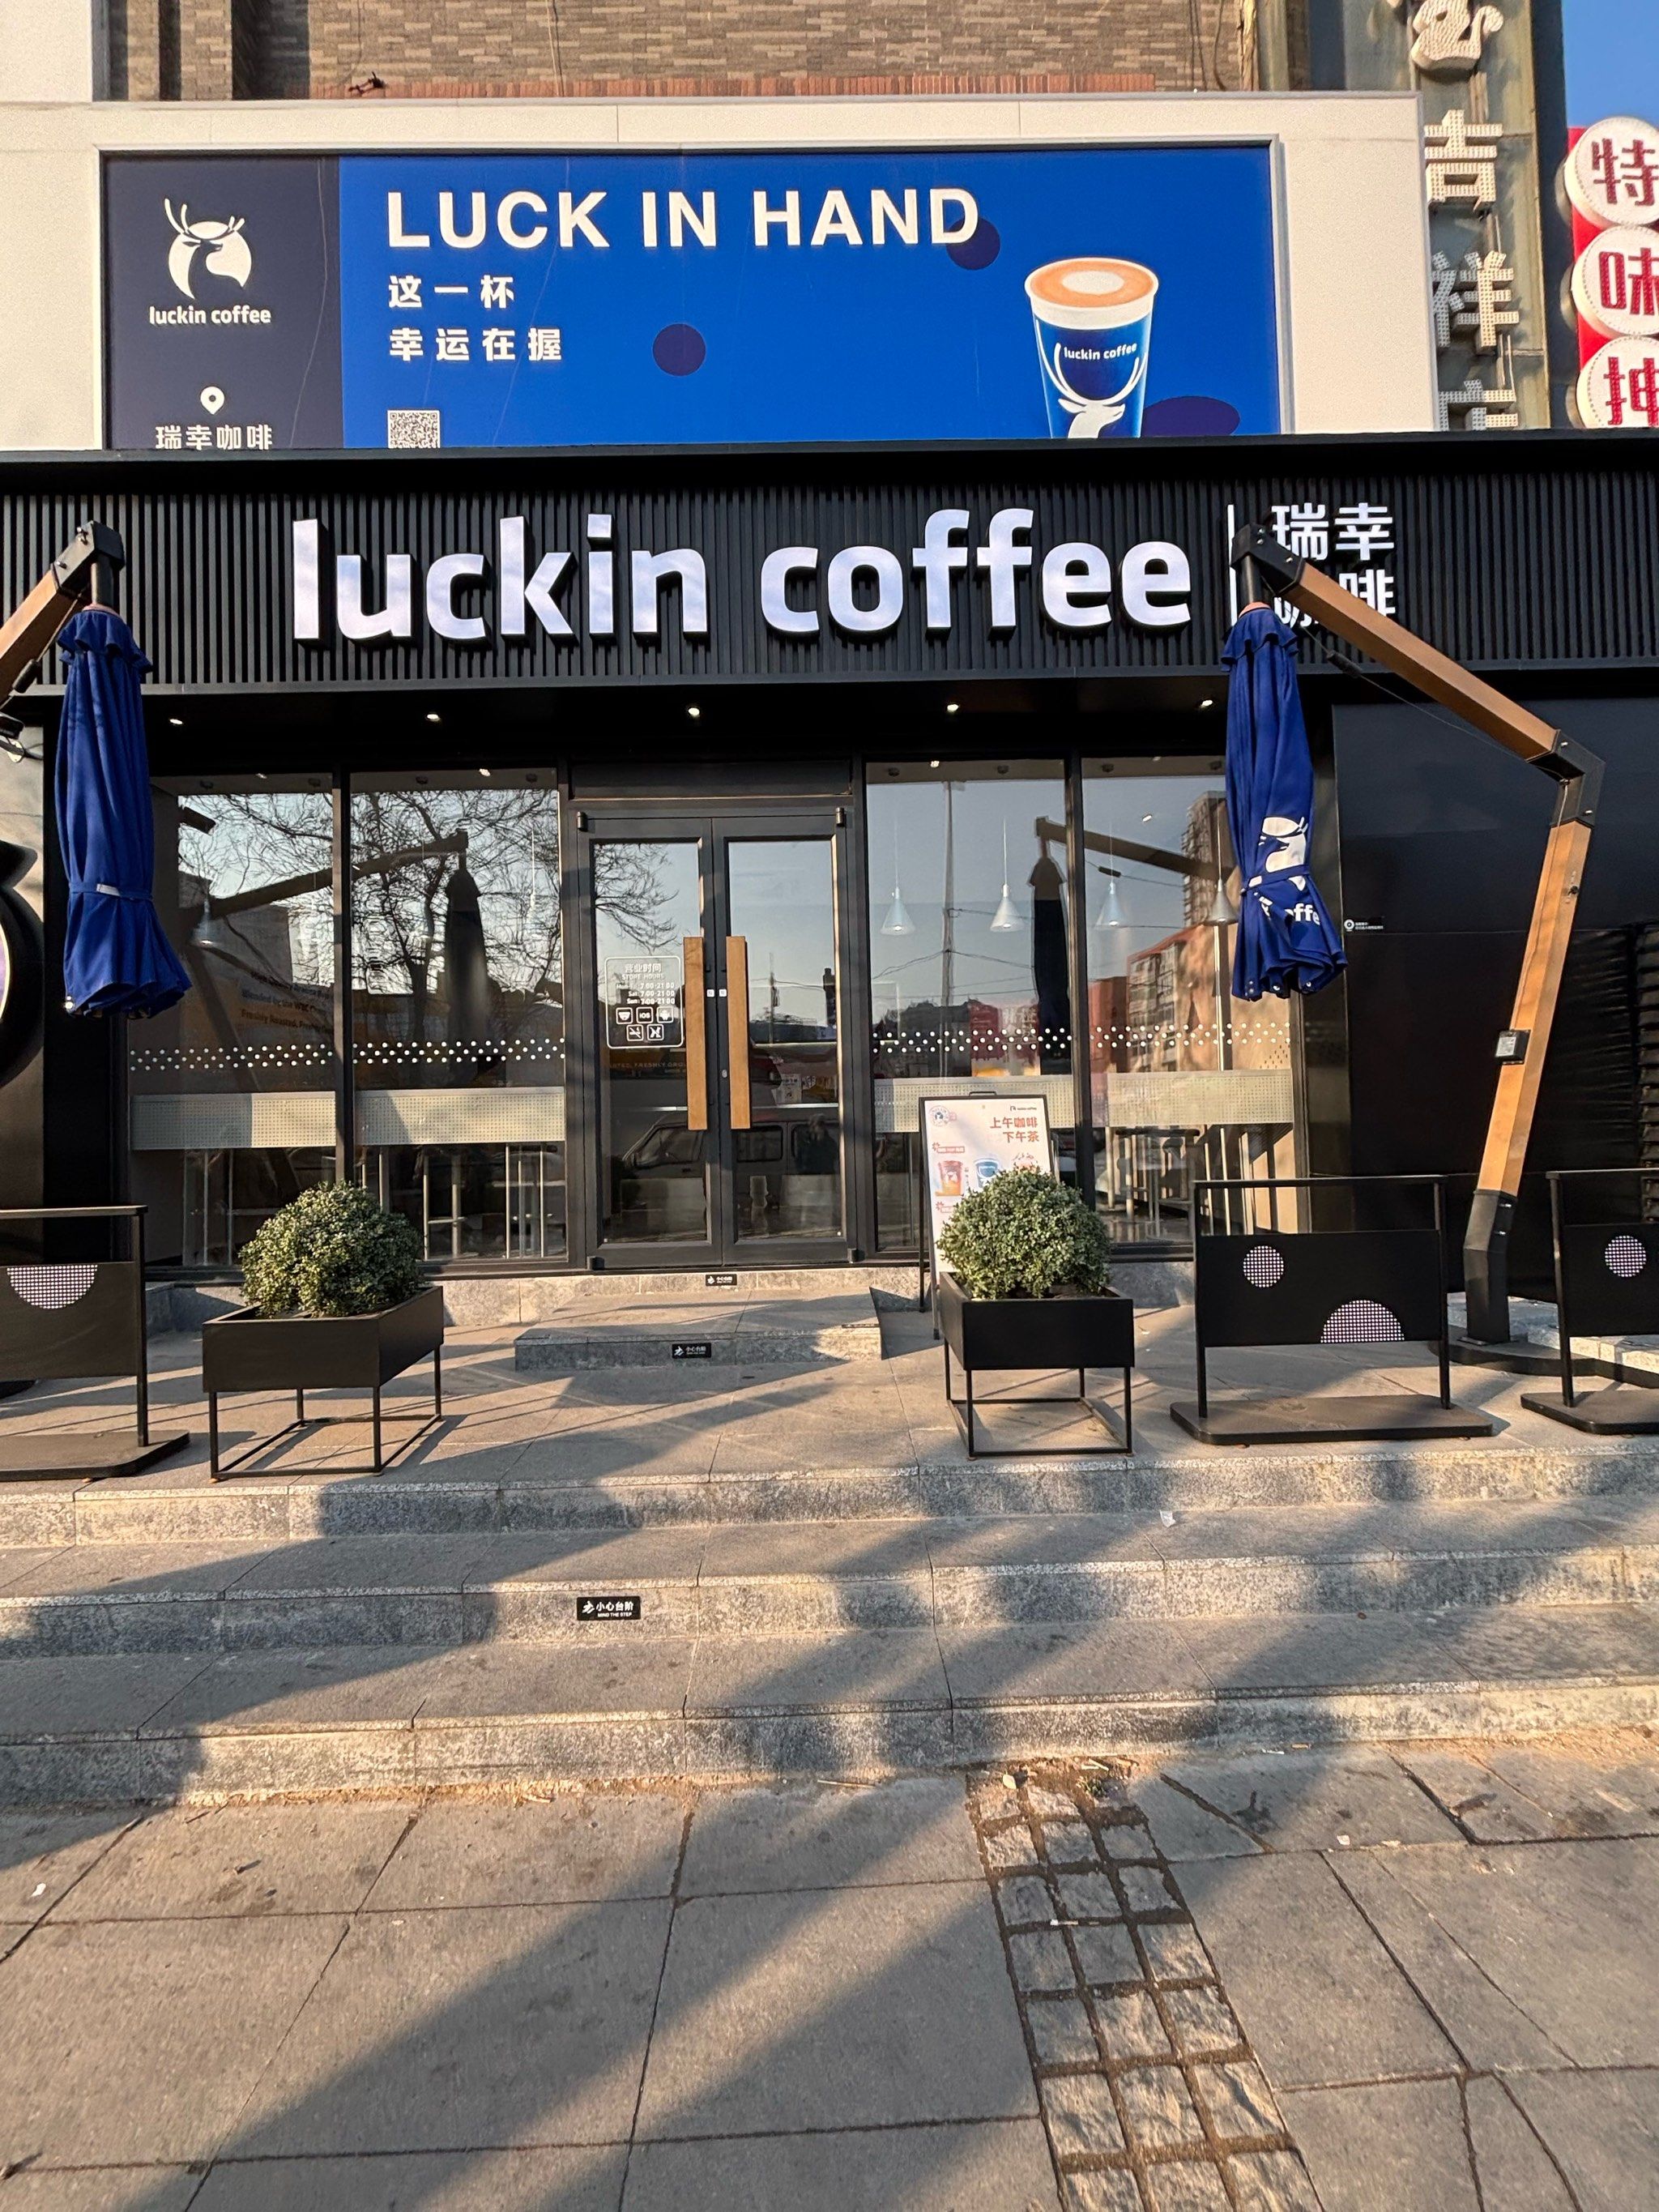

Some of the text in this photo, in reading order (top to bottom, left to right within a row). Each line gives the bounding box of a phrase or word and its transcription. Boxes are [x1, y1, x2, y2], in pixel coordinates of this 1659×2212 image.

[388, 188, 979, 249] LUCK IN HAND
[389, 275, 514, 309] 这一杯
[149, 305, 271, 324] luckin coffee
[389, 327, 562, 361] 幸运在握
[1064, 343, 1137, 361] luckin coffee
[155, 424, 273, 450] 瑞幸咖啡
[1271, 502, 1394, 561] 瑞幸
[292, 508, 1191, 640] luckin coffee
[625, 963, 662, 973] 营业时间
[990, 1117, 1038, 1129] 上午咖啡
[1003, 1130, 1039, 1143] 下午茶
[596, 1601, 634, 1612] 小心台阶
